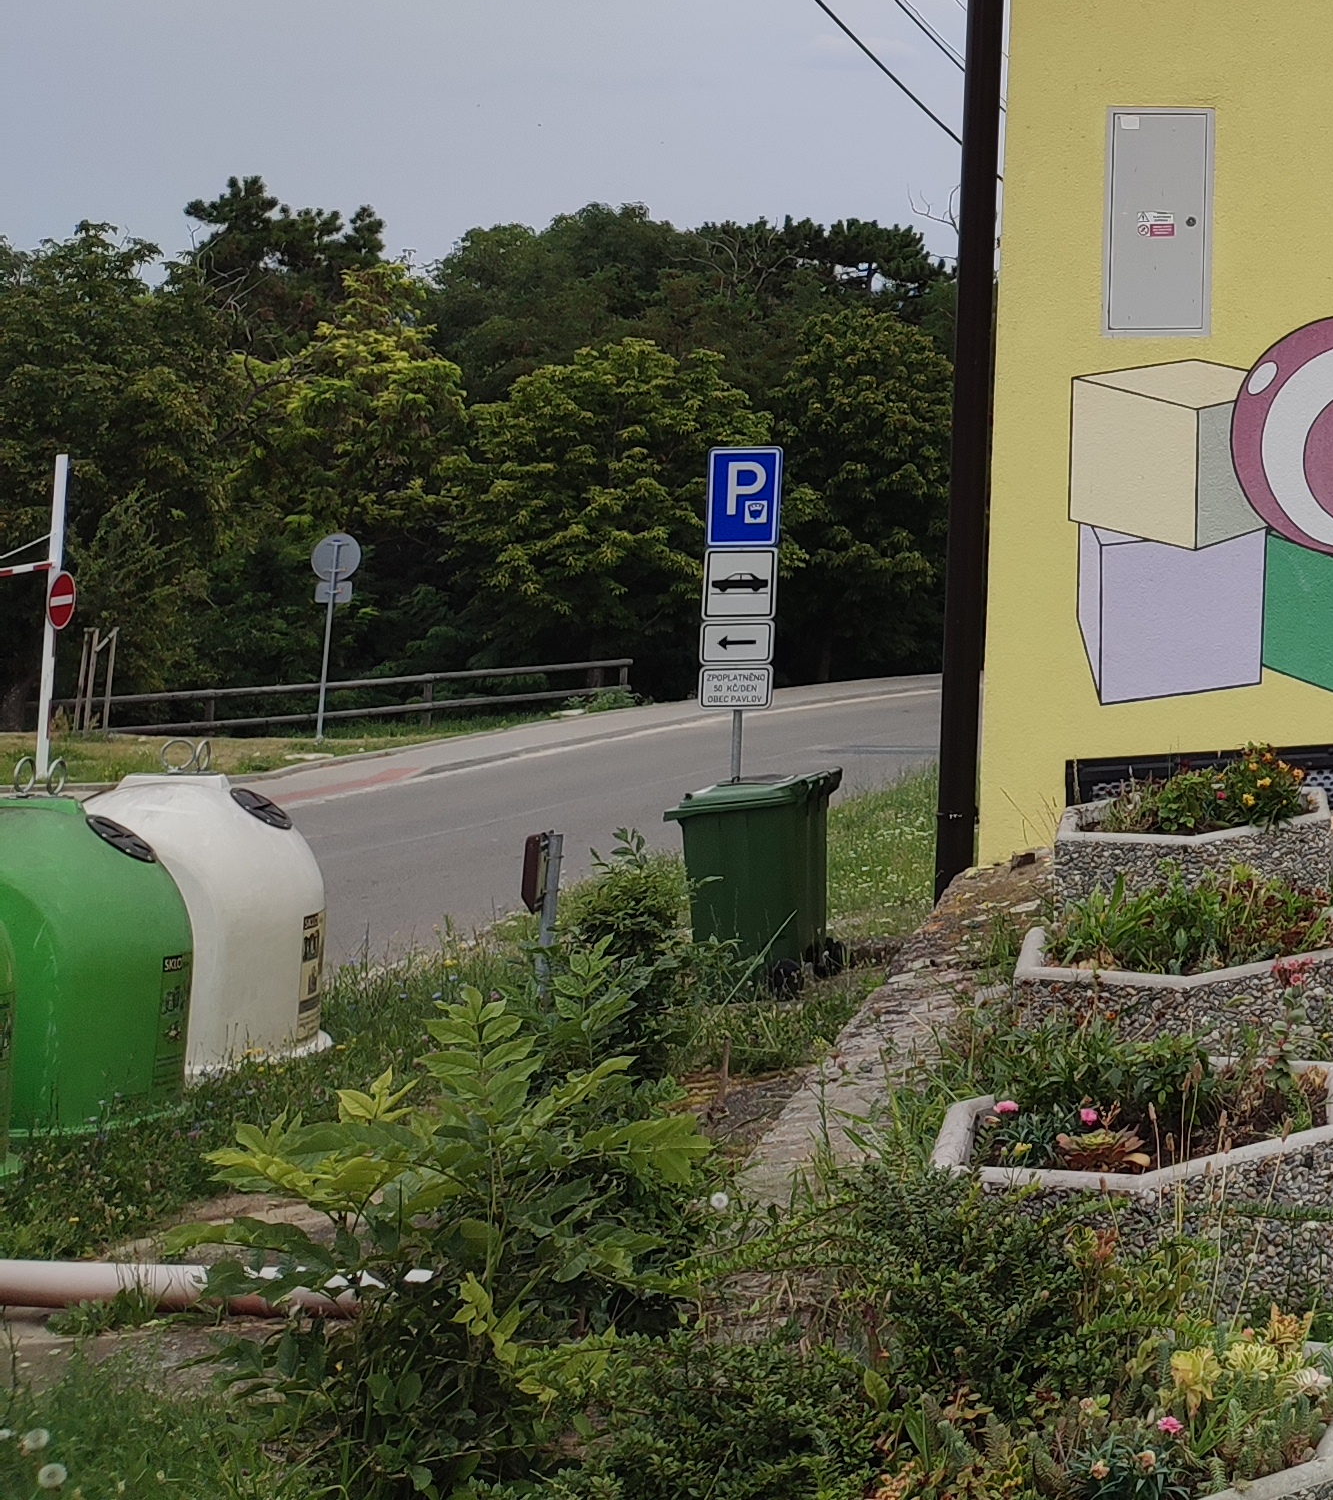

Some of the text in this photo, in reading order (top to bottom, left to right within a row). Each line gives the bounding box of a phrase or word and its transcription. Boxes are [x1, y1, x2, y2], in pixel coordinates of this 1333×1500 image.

[726, 461, 767, 515] P
[706, 673, 766, 682] ZPOPLATNĚNO
[713, 684, 723, 692] 50
[707, 695, 762, 703] OBEC PAVLOV
[164, 957, 182, 971] SKLO
